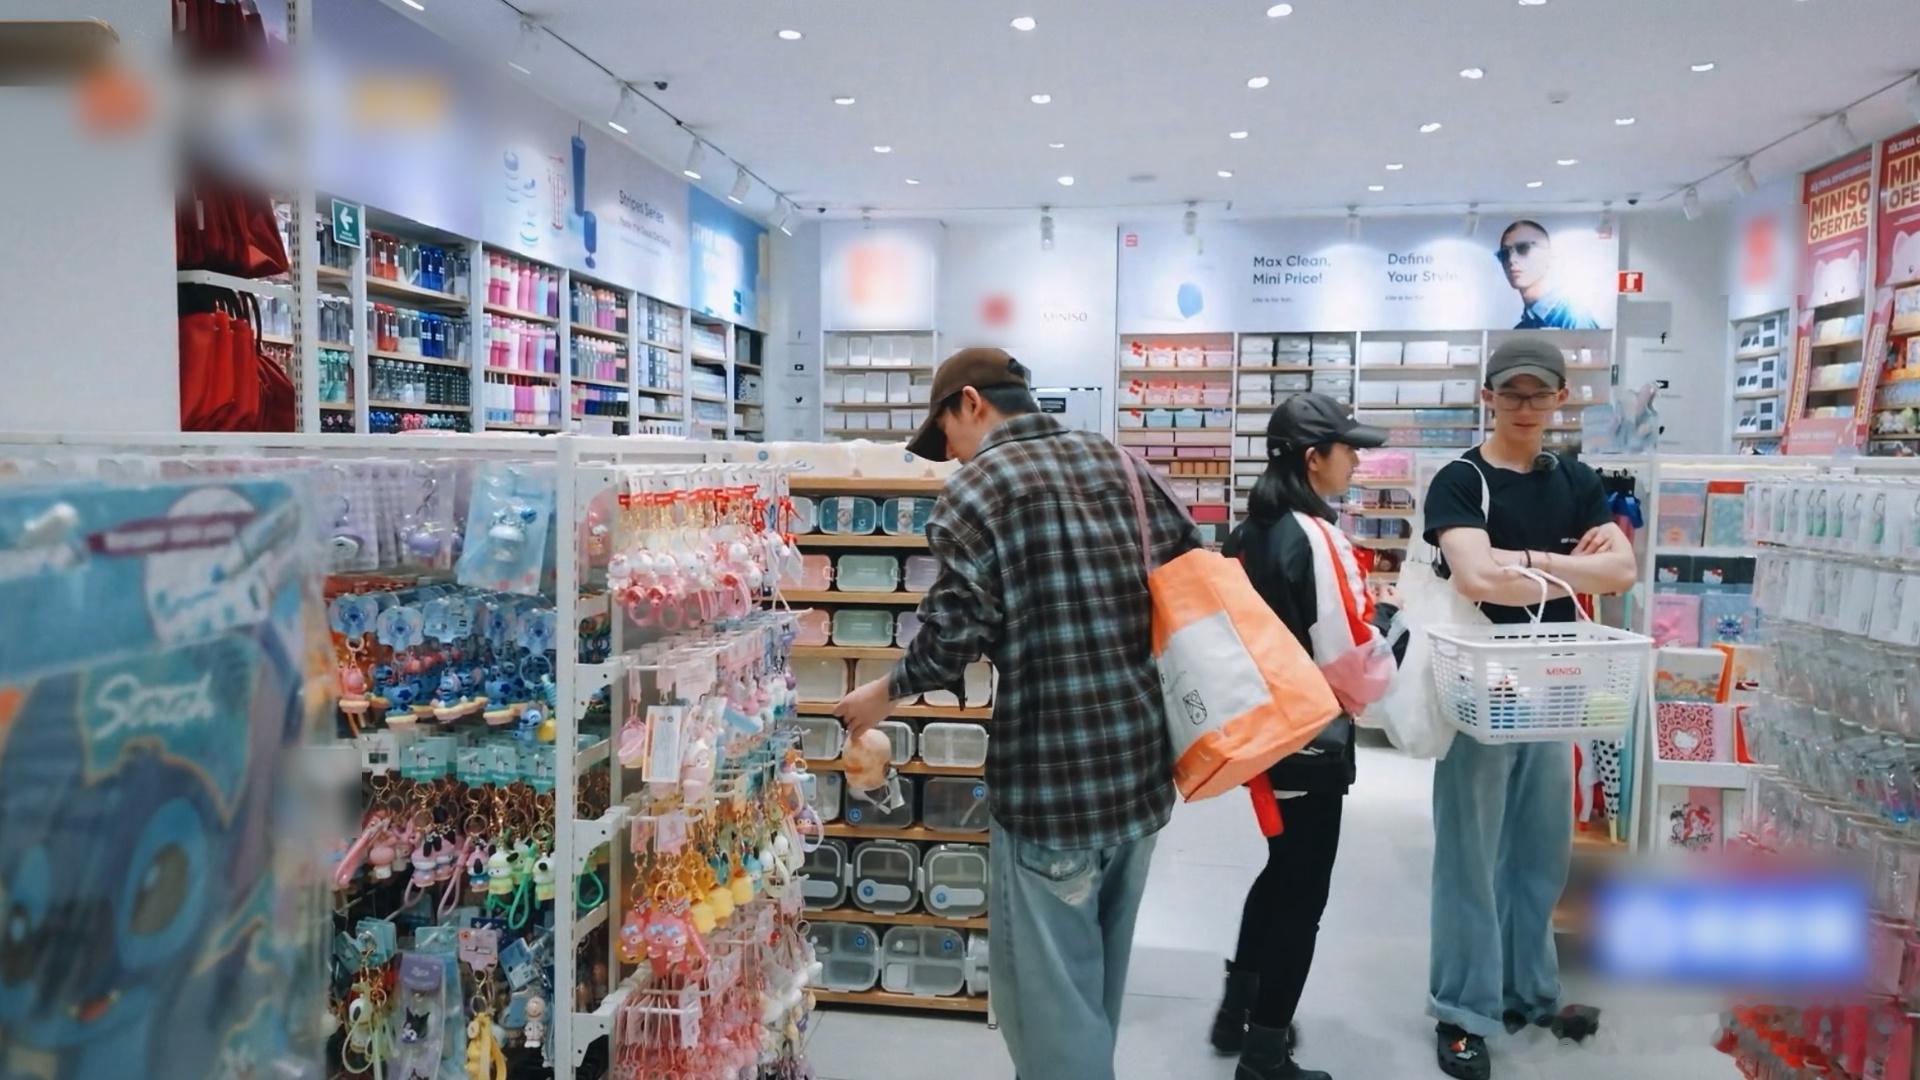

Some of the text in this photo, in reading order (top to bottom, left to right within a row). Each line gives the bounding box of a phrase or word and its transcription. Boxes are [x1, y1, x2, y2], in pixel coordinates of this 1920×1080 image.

[1810, 181, 1871, 222] MINISO
[1809, 207, 1868, 240] OFERTAS
[1253, 256, 1282, 267] Max
[1387, 253, 1434, 265] Define
[1252, 272, 1322, 285] Mini Price!
[1387, 271, 1418, 283] Your
